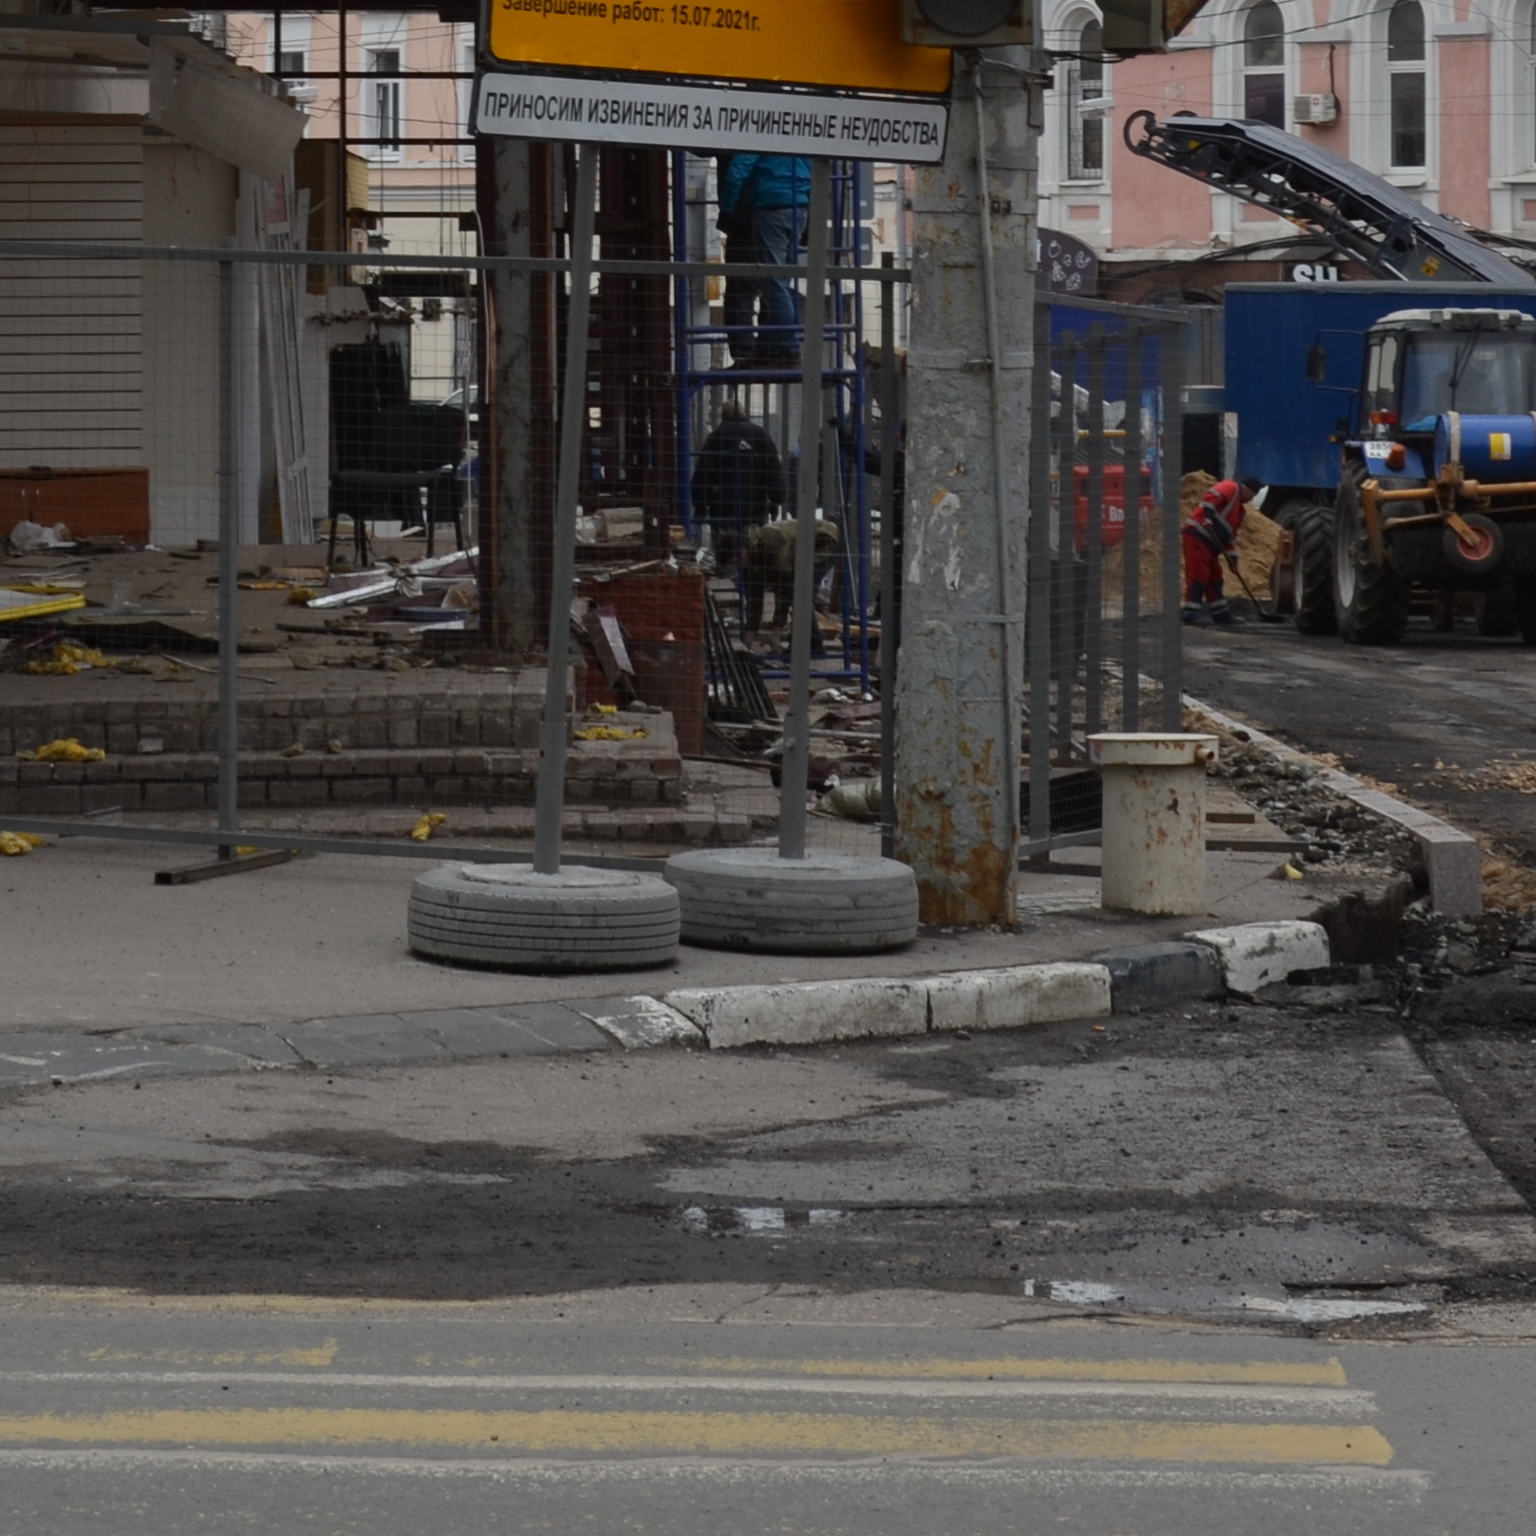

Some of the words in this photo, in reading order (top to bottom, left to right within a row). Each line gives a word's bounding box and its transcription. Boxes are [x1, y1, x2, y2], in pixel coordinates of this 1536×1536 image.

[613, 1, 664, 23] работ:
[671, 4, 760, 31] 15.07.2021г.
[484, 92, 583, 122] ПРИНОСИМ
[588, 97, 689, 130] ИЗВИНЕНИЯ
[692, 105, 713, 130] ЗА
[718, 107, 837, 139] ПРИЧИНЕННЫЕ
[841, 115, 939, 146] НЕУДОБСТВА
